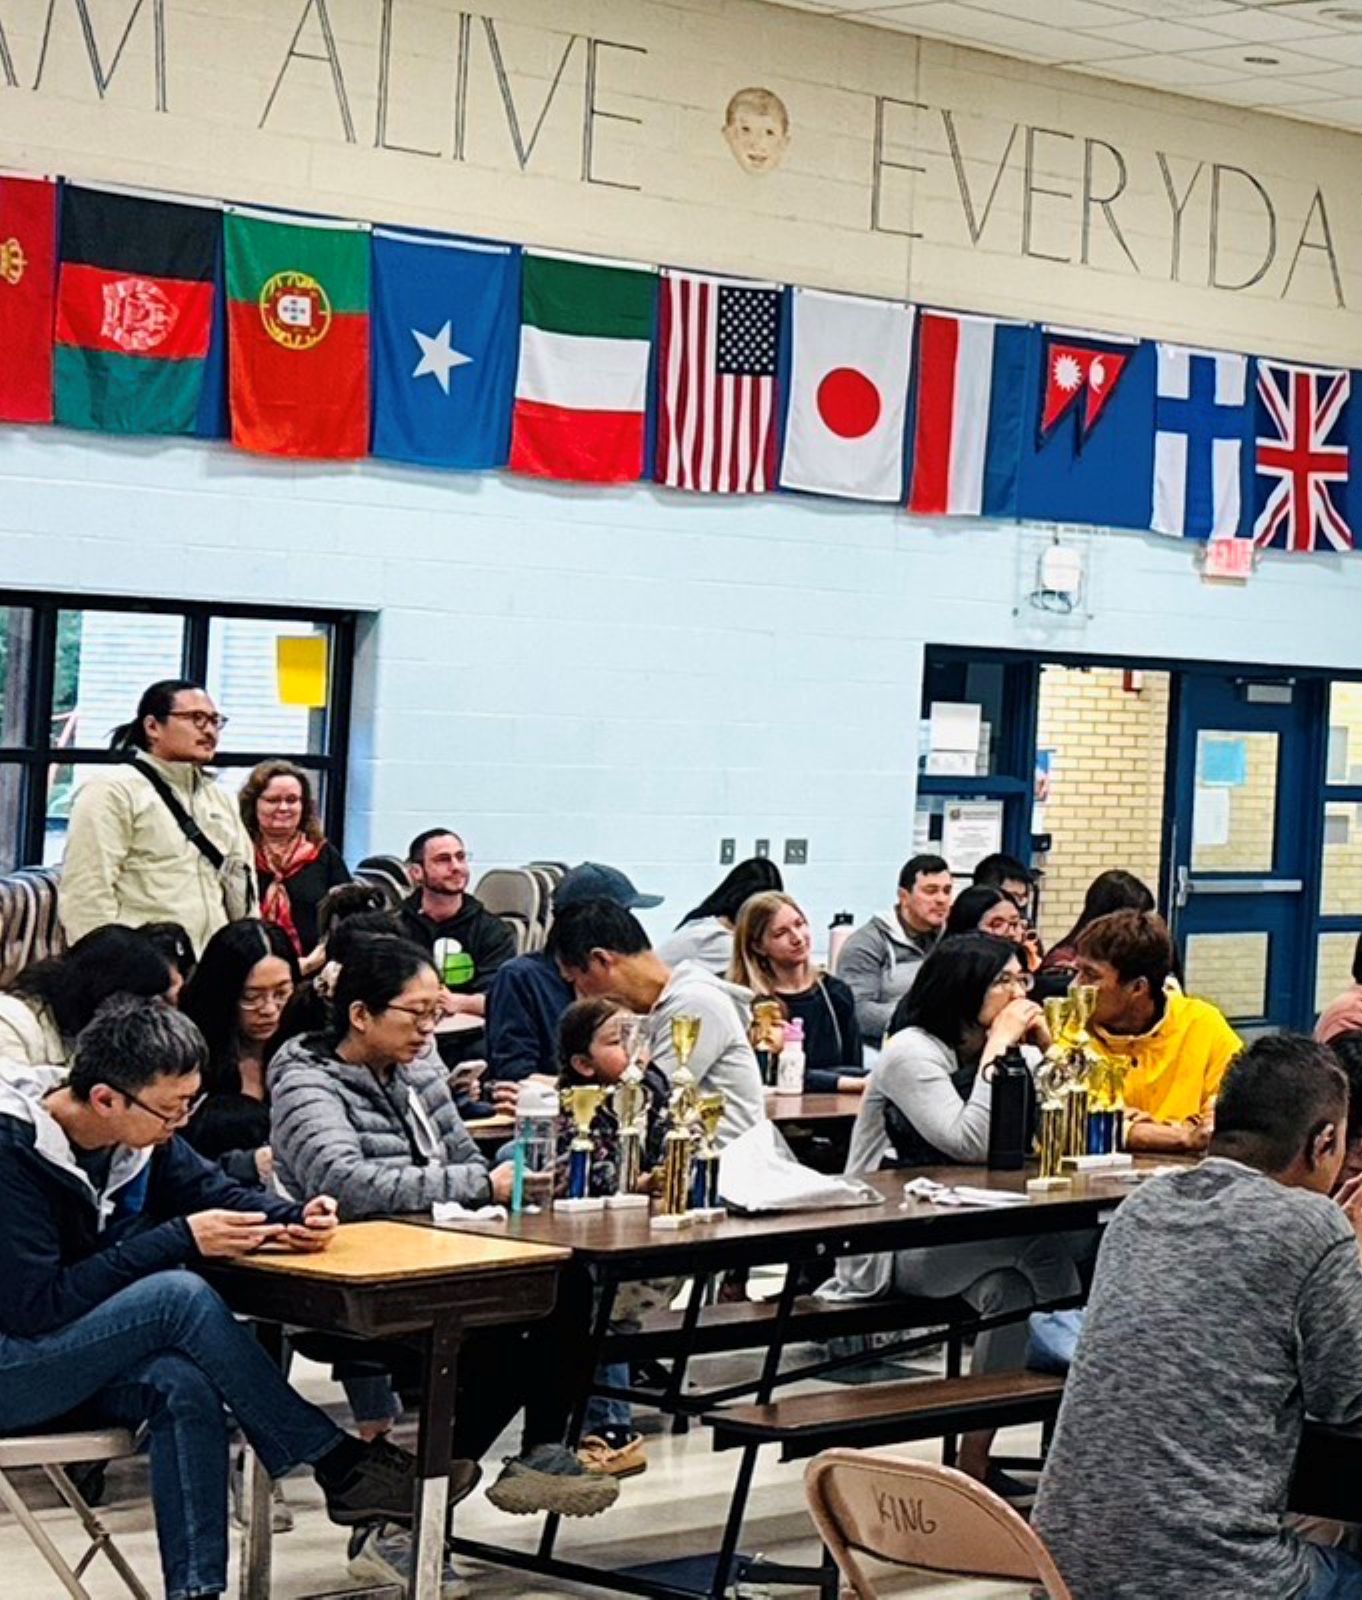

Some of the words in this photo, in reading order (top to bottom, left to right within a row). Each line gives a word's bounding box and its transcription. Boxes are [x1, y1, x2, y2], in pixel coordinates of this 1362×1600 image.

[0, 0, 168, 112] M
[258, 0, 649, 191] ALIVE
[871, 1483, 937, 1534] KING
